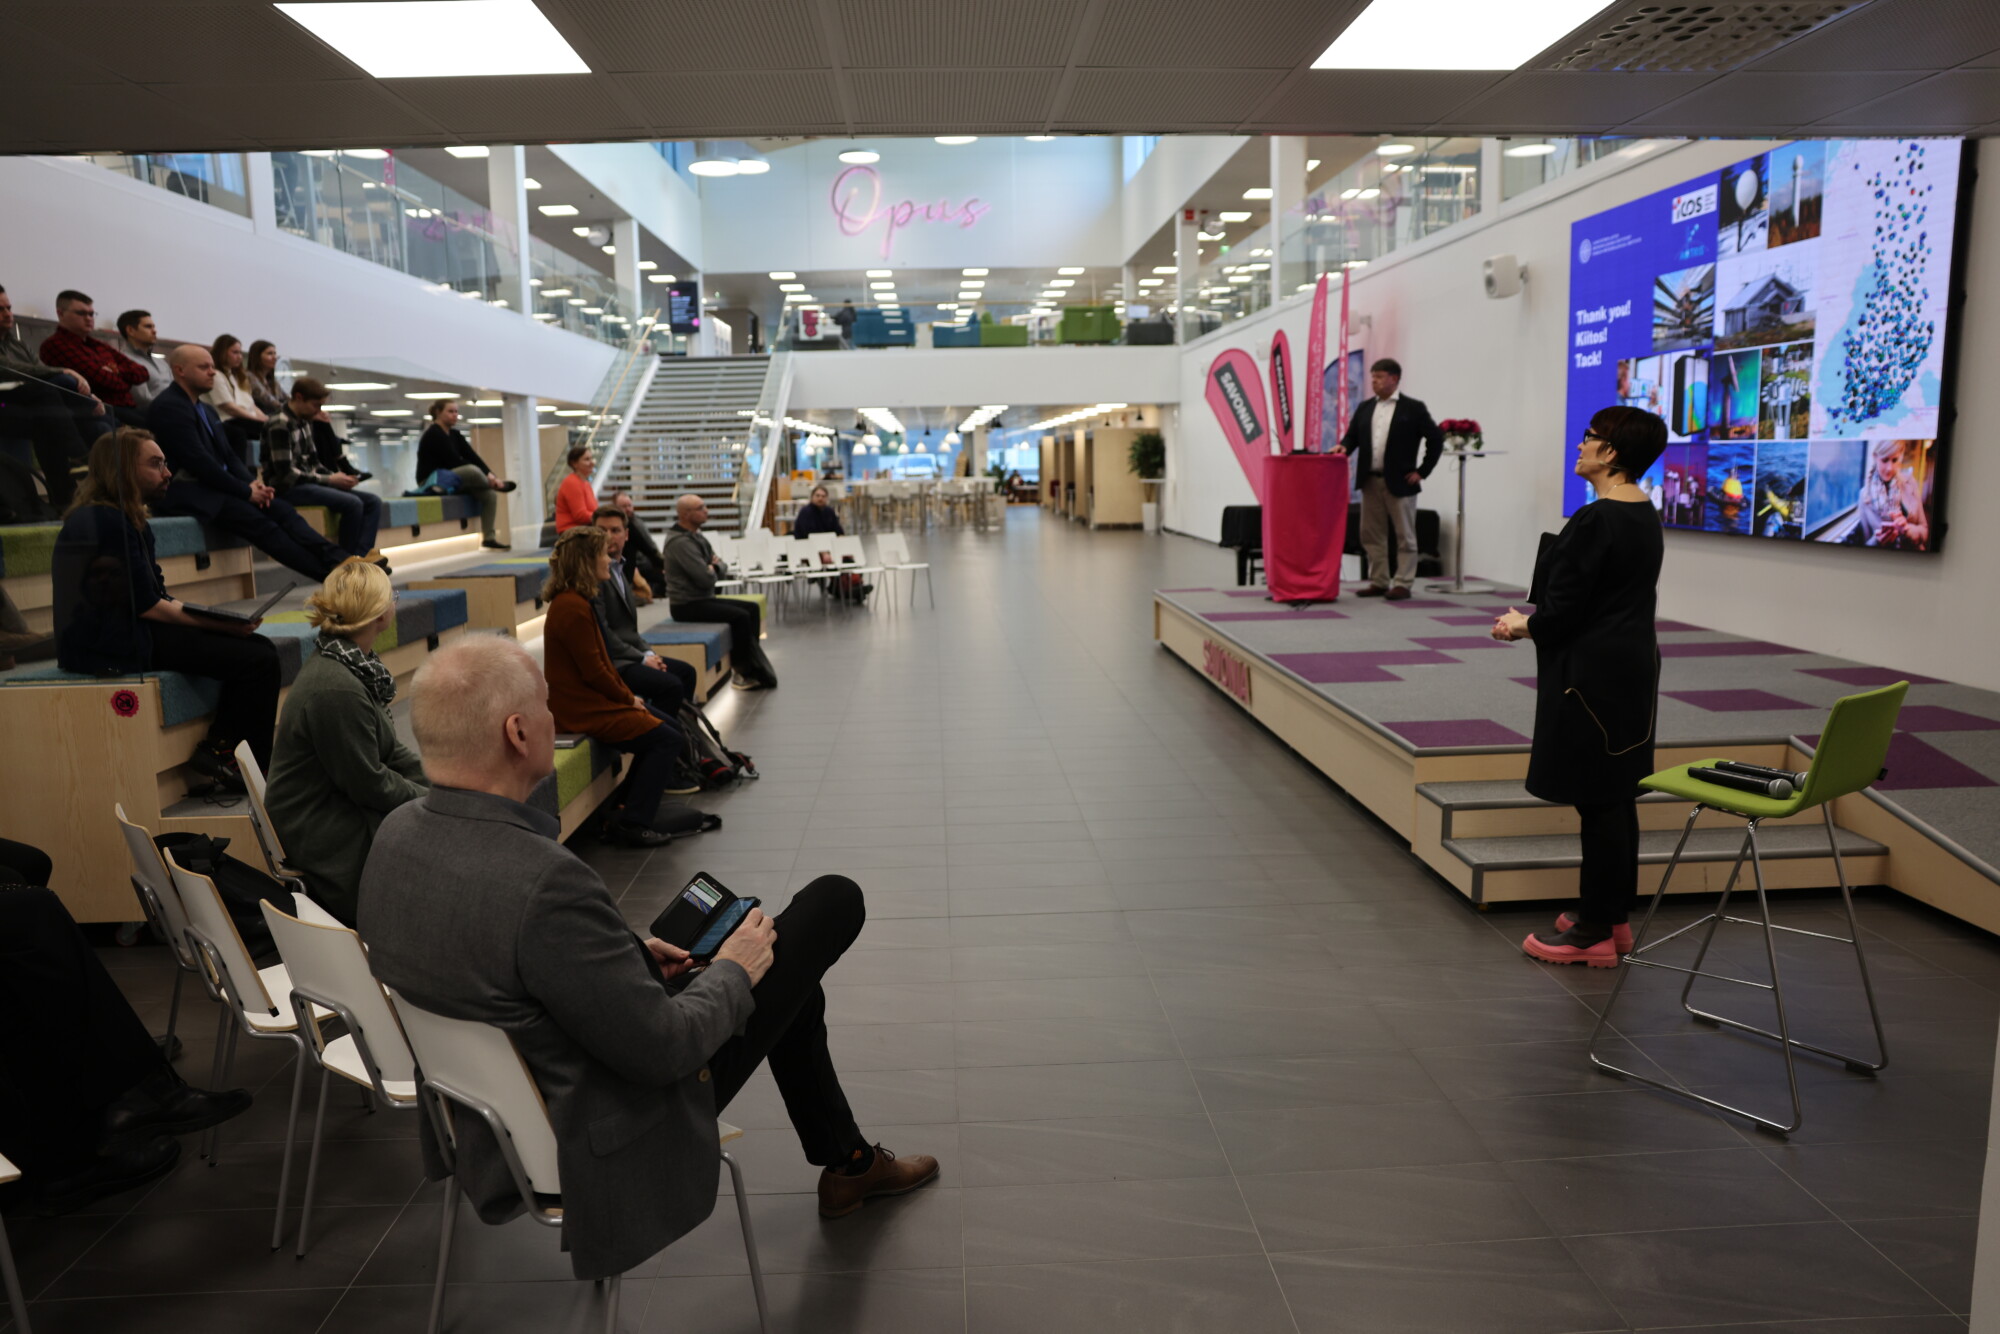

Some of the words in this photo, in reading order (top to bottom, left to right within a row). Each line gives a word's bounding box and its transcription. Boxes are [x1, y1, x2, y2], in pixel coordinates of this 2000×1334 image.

[831, 165, 991, 261] Opus
[1576, 305, 1607, 326] Thank
[1608, 299, 1631, 324] you!
[1575, 327, 1608, 347] Kiitos!
[1575, 349, 1602, 368] Tack!
[1221, 372, 1255, 435] SAVONIA
